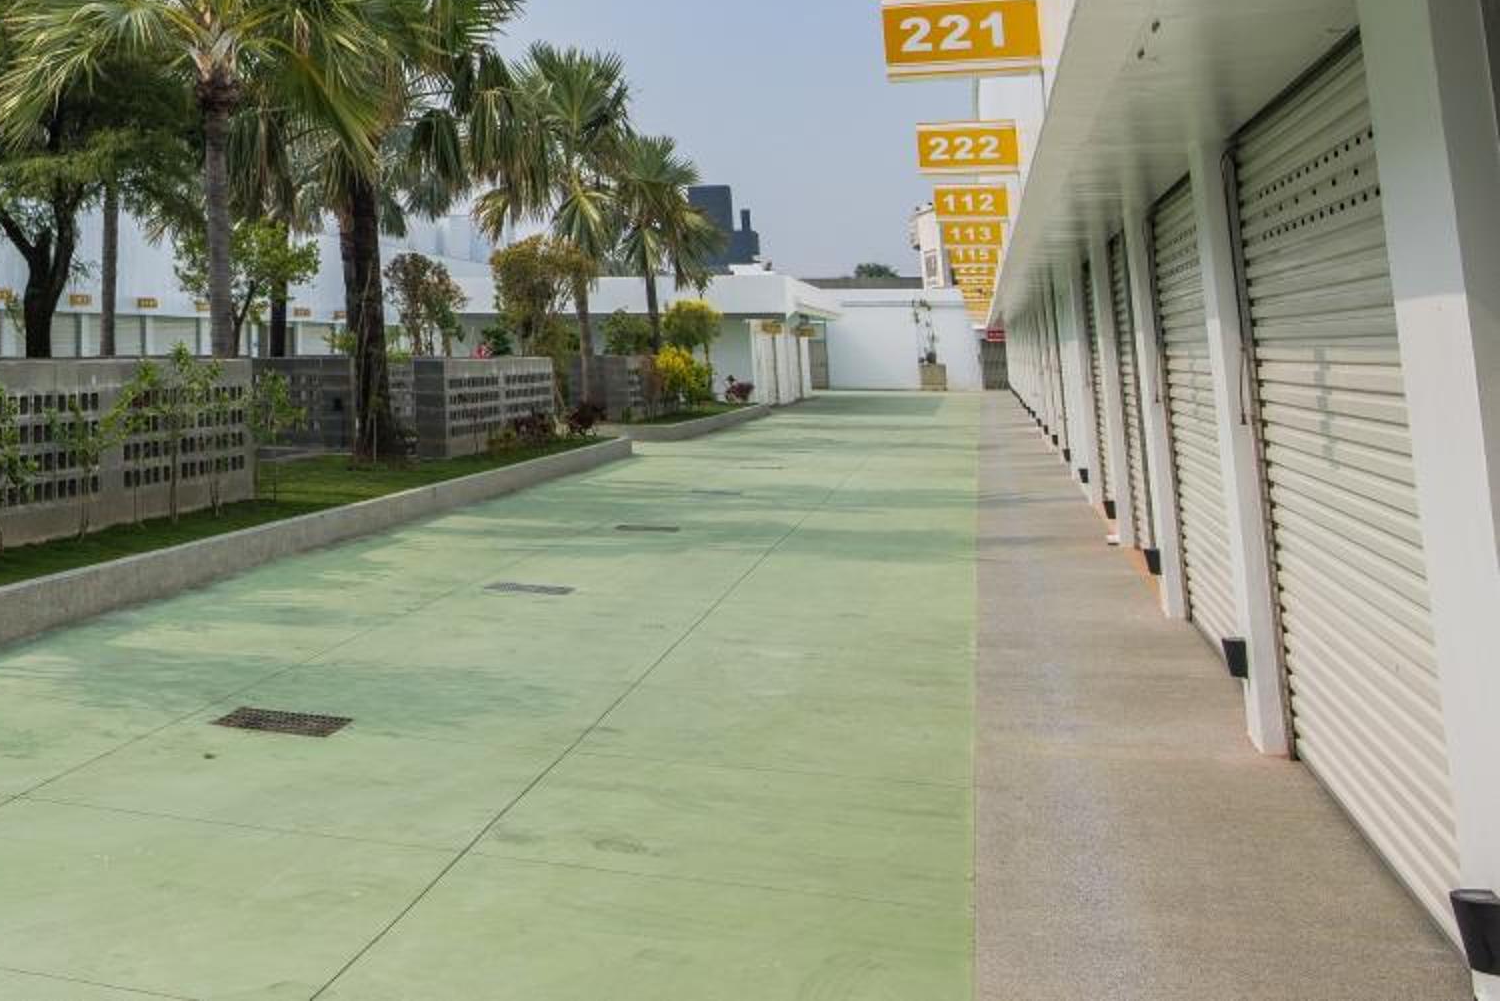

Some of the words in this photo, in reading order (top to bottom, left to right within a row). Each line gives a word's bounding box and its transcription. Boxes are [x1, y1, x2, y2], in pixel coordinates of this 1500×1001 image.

[900, 11, 1005, 53] 221
[928, 136, 1000, 161] 222
[943, 194, 994, 212] 112
[949, 227, 991, 241] 113
